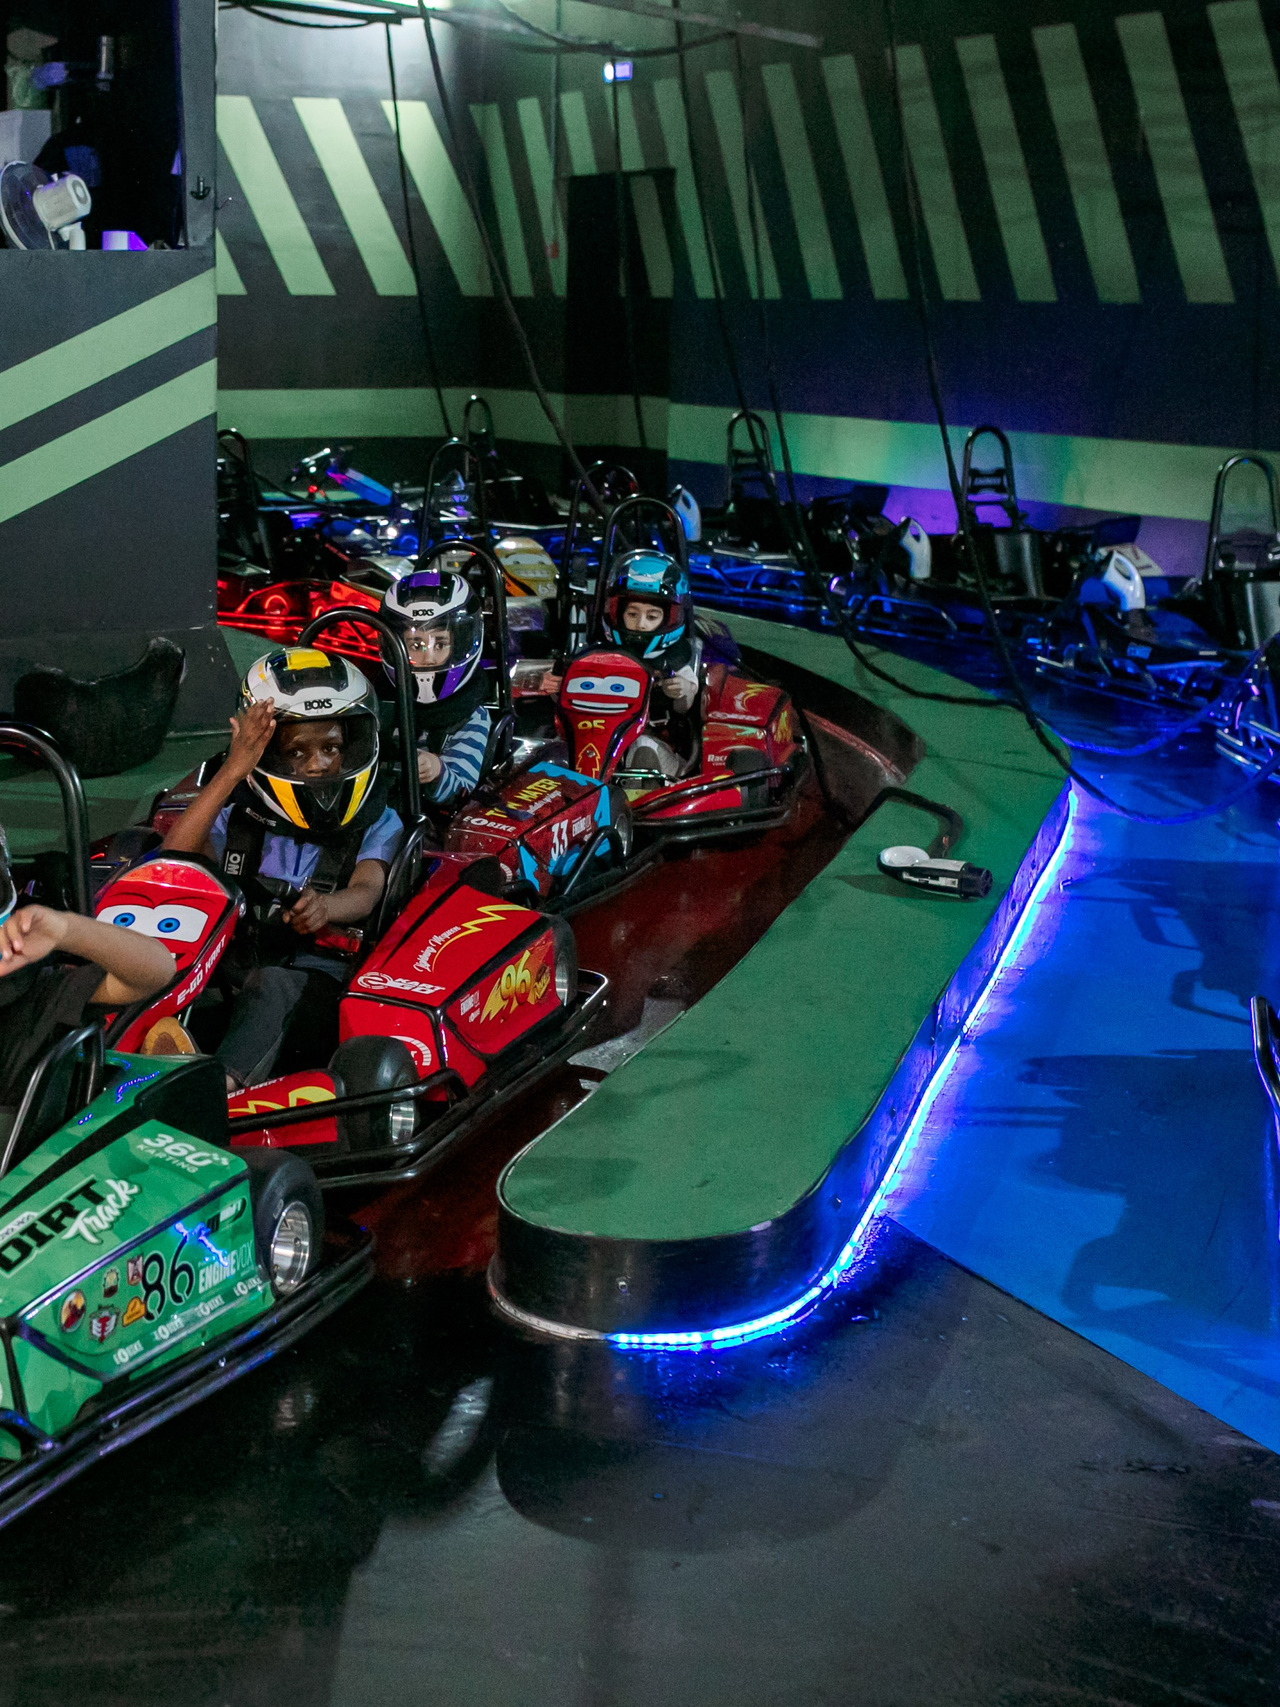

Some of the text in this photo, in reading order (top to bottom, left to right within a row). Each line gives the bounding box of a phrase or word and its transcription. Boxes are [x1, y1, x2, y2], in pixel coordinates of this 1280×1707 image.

[551, 819, 569, 862] 33
[136, 1143, 200, 1174] KARTING
[143, 1133, 217, 1168] 360
[61, 1179, 140, 1244] Track
[141, 1236, 195, 1322] 86
